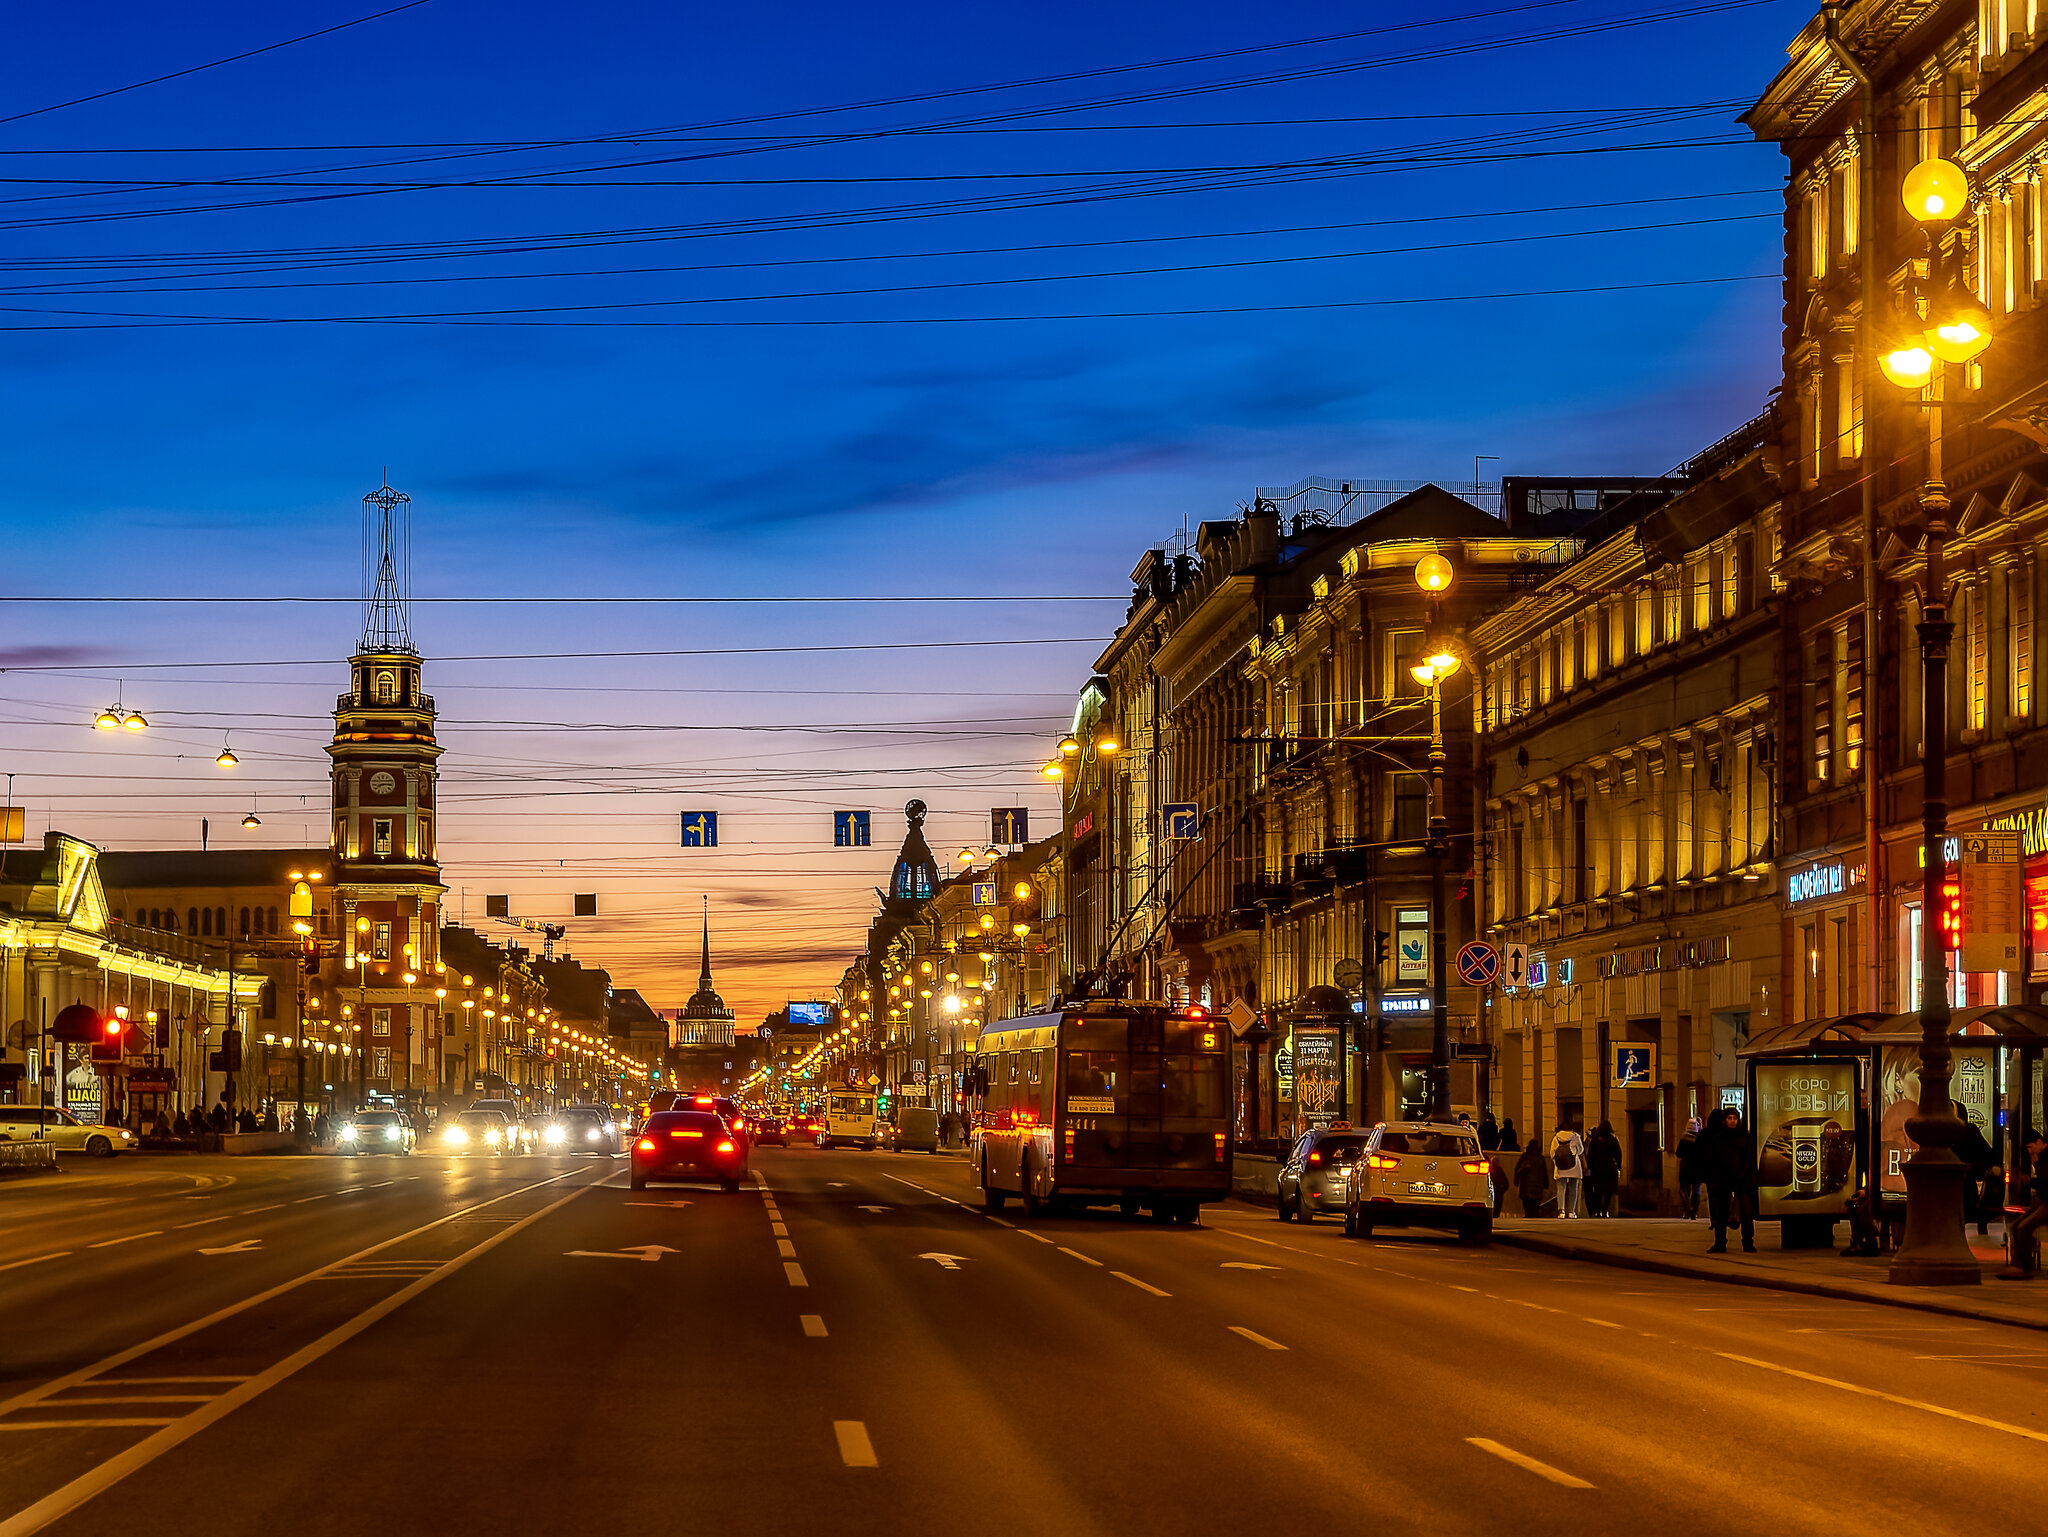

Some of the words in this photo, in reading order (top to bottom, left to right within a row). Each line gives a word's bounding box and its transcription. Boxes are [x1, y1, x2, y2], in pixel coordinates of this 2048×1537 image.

[1382, 1000, 1419, 1012] БРЫНЗА
[1204, 1033, 1215, 1047] 5
[1781, 1079, 1830, 1091] СКОРО
[1961, 1079, 1970, 1092] 13
[1976, 1079, 1985, 1093] 14
[1763, 1090, 1850, 1112] НОВЫЙ
[1960, 1093, 1986, 1105] АПРЕЛЯ
